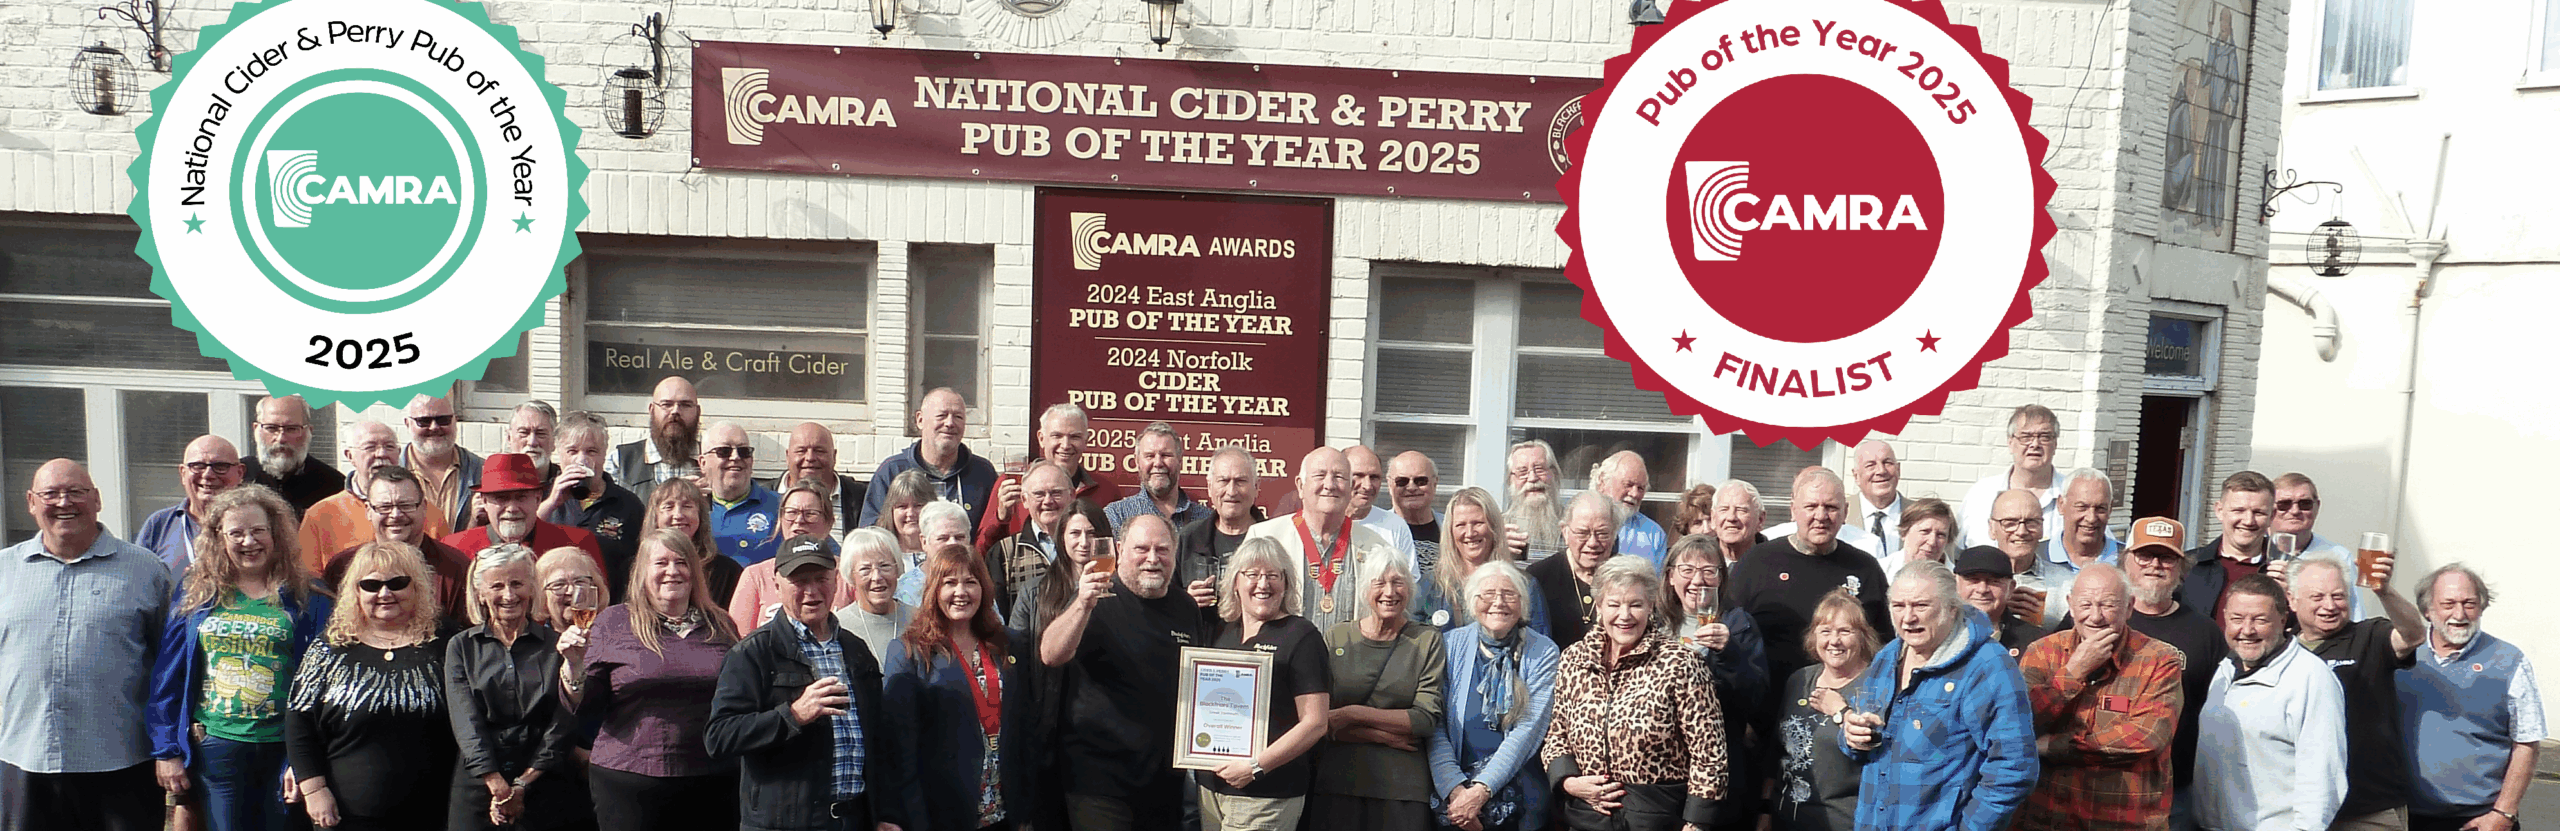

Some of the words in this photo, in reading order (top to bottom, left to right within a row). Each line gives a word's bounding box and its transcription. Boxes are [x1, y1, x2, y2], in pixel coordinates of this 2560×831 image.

[750, 92, 898, 128] CAMRA
[913, 76, 1158, 118] NATIONAL
[1170, 86, 1320, 125] CIDER
[1330, 94, 1366, 127] &
[1377, 96, 1532, 133] PERRY
[960, 122, 1051, 158] PUB
[1065, 126, 1131, 160] OF
[1140, 129, 1234, 165] THE
[1241, 133, 1367, 171] YEAR
[1377, 140, 1481, 175] 2025
[1090, 230, 1201, 257] CAMRA
[1208, 237, 1296, 259] AWARDS
[1087, 283, 1141, 305] 2024
[1146, 286, 1195, 307] East
[1200, 288, 1277, 313] Anglia
[1069, 308, 1119, 329] PUB
[1126, 310, 1163, 331] OF
[1168, 312, 1220, 333] THE
[1222, 314, 1293, 336] YEAR
[605, 348, 651, 370] Real
[658, 349, 694, 371] Ale
[701, 351, 718, 372] &
[725, 352, 780, 374] Craft
[788, 353, 849, 376] Cider
[1107, 346, 1161, 368] 2024
[1166, 349, 1253, 371] Norfolk
[2148, 337, 2190, 361] Welcome
[1138, 370, 1221, 392] CIDER
[1068, 390, 1117, 411] PUB
[1124, 392, 1161, 412] OF
[1165, 393, 1217, 414] THE
[1219, 395, 1290, 417] YEAR
[1086, 428, 1137, 449] 2025
[1079, 453, 1115, 472] UB
[1180, 456, 1213, 475] HE
[1254, 458, 1288, 478] AR
[198, 616, 259, 637] BEER
[258, 623, 289, 641] 2023
[202, 633, 279, 659] FESTIVAL
